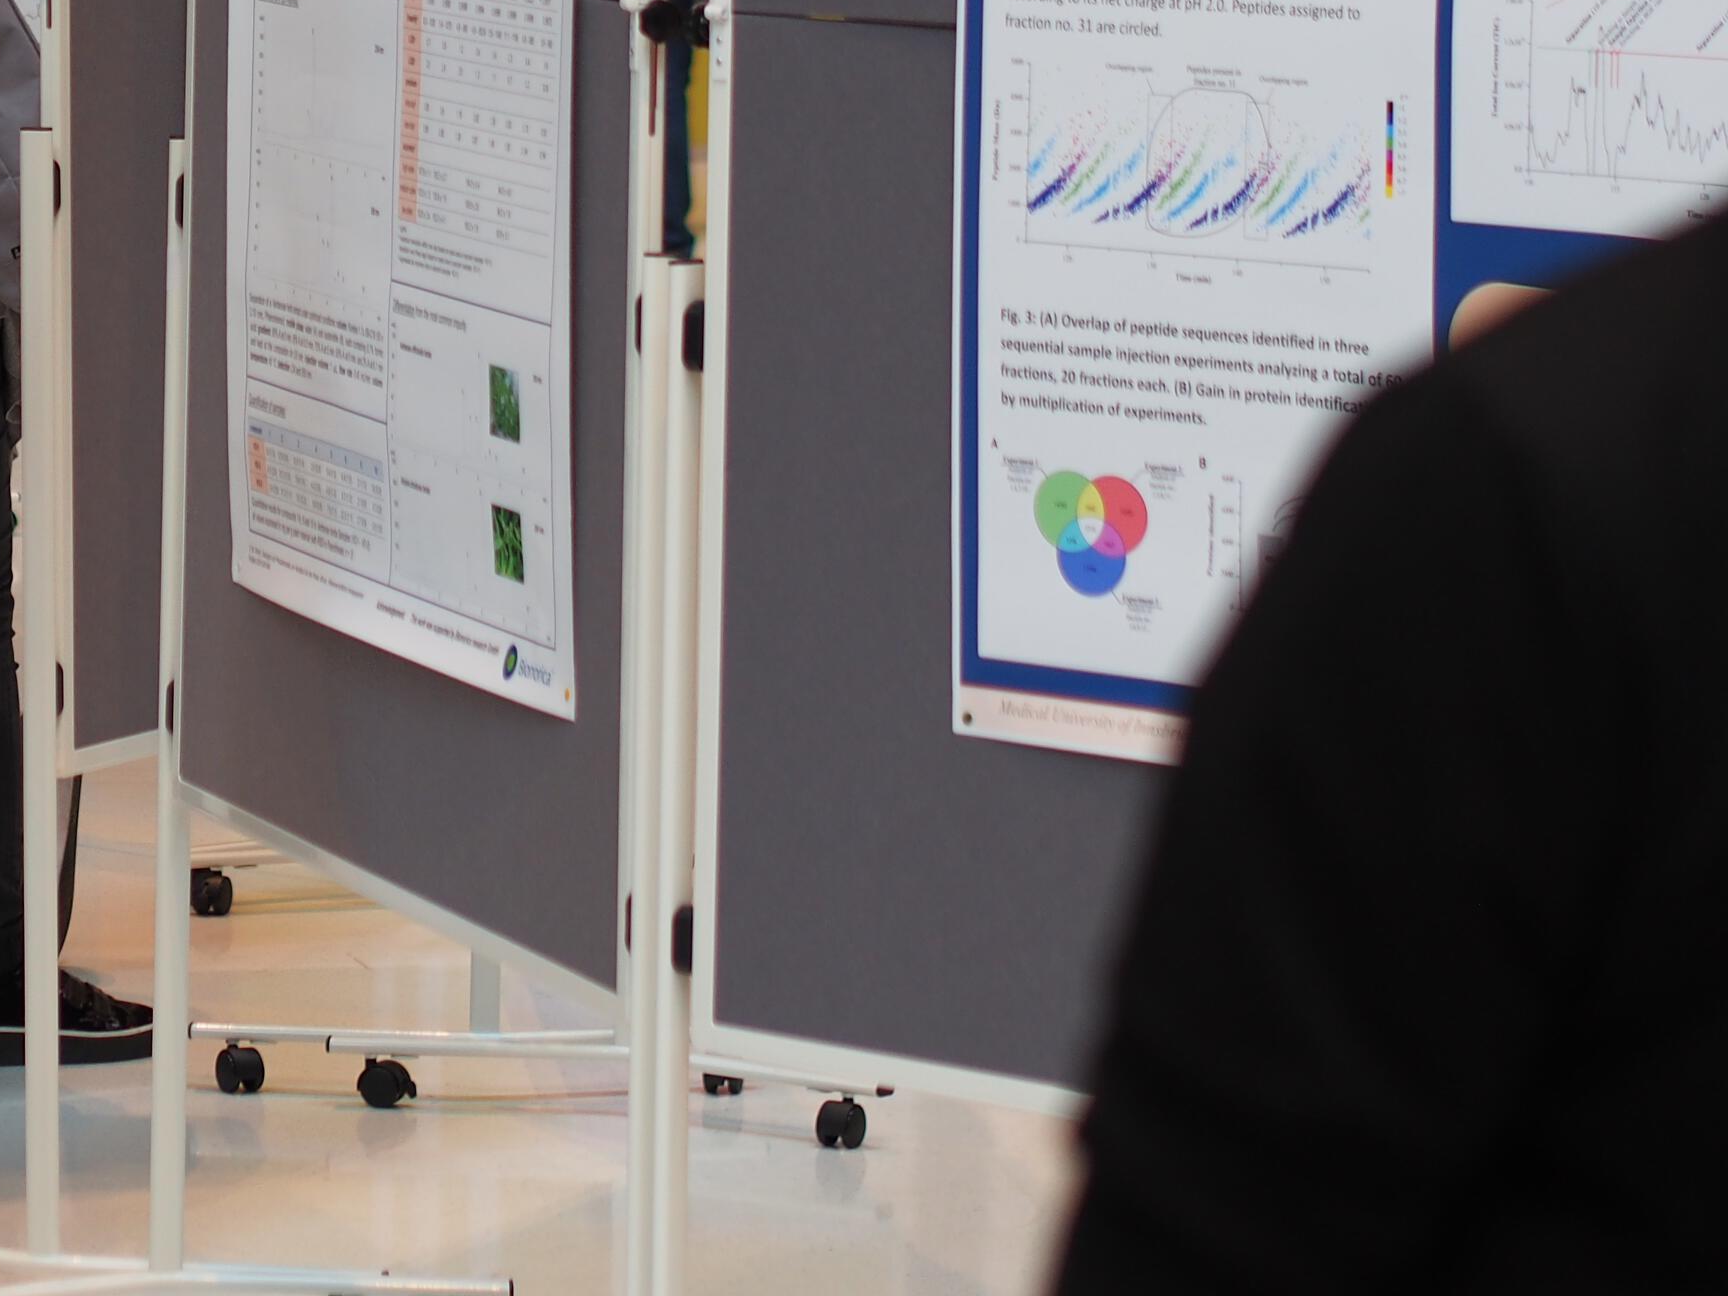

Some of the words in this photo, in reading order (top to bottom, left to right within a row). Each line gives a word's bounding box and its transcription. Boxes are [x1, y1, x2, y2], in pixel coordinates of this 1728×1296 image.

[1000, 308, 1020, 326] Fig.
[1025, 310, 1035, 324] 3:
[1040, 311, 1057, 328] (A)
[1061, 314, 1110, 333] Overlap
[1113, 318, 1126, 332] of
[1130, 320, 1178, 339] peptide
[1182, 327, 1248, 345] sequences
[1252, 331, 1314, 349] identified
[1318, 338, 1329, 351] in
[1334, 338, 1369, 355] three
